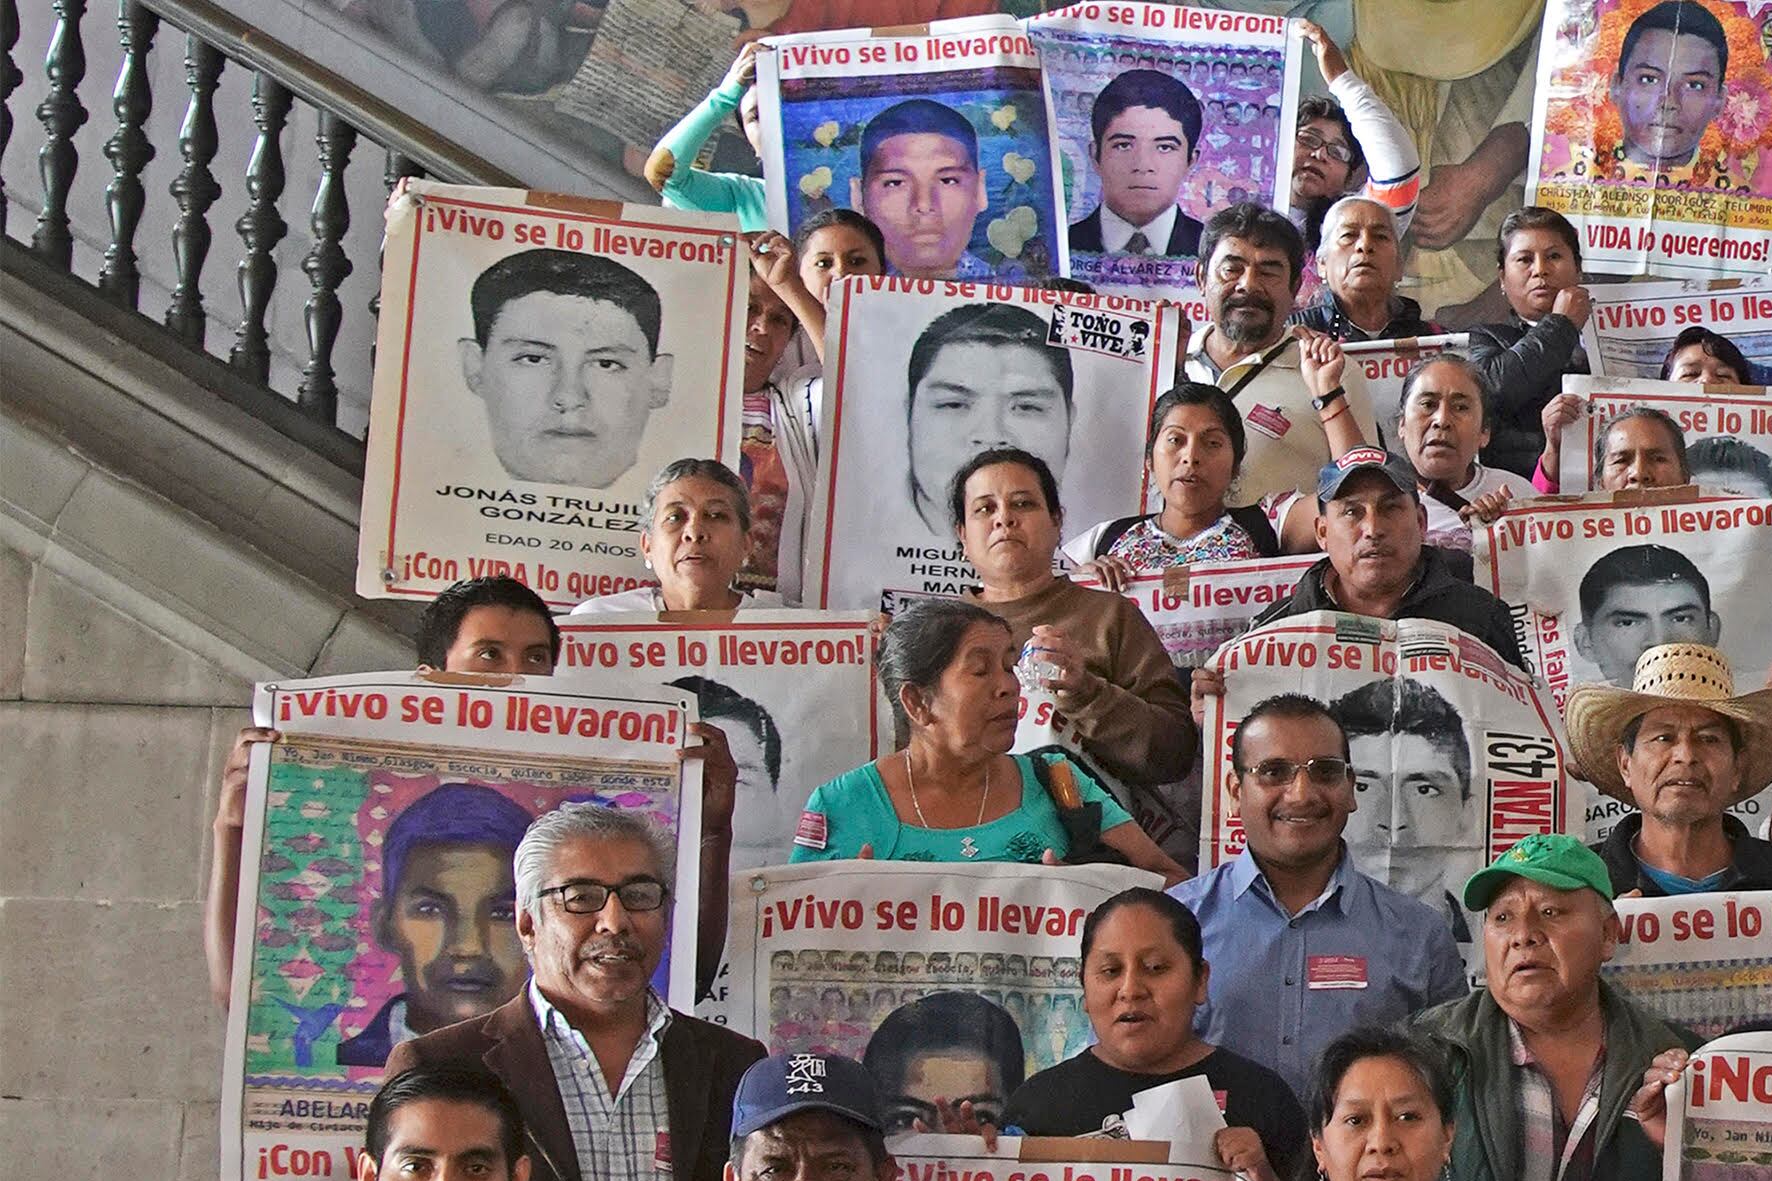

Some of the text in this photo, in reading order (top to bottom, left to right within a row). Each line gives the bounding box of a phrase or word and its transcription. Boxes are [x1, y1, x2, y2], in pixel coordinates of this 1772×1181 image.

[1109, 6, 1284, 35] se lo llevaron!
[782, 34, 1036, 70] ¡Vivo se lo llevaron!
[427, 207, 724, 265] ¡Vivo se lo llevaron!
[1587, 224, 1770, 263] VIDA lo queremos!
[1598, 303, 1666, 330] ¡Vivo
[1674, 303, 1701, 325] se
[1711, 297, 1734, 322] lo
[1078, 329, 1125, 355] VIVE
[1679, 406, 1708, 432] se
[1717, 407, 1741, 433] lo
[435, 484, 538, 506] JONÁS
[479, 505, 642, 533] GONZÁLEZ
[1500, 515, 1574, 551] ¡Vivo
[1583, 515, 1615, 538] se
[1625, 512, 1652, 536] lo
[485, 533, 637, 558] EDAD 20 AÑOS
[404, 551, 458, 582] ¡Con
[537, 564, 559, 593] lo
[911, 564, 981, 580] HERN
[557, 634, 865, 669] ivo se lo llevaron!
[1230, 636, 1318, 671] ¡Vivo
[1327, 644, 1362, 670] se
[1373, 643, 1398, 675] lo
[280, 689, 678, 746] ¡Vivo se lo llevaron!
[1487, 731, 1557, 778] 43!
[762, 895, 865, 938] ¡Vivo
[876, 900, 918, 931] se
[931, 895, 965, 932] lo
[1672, 909, 1715, 941] se
[1726, 901, 1762, 938] lo
[1694, 1128, 1716, 1144] Yo,
[1725, 1129, 1752, 1142] Jan
[258, 1144, 332, 1180] ¡Con
